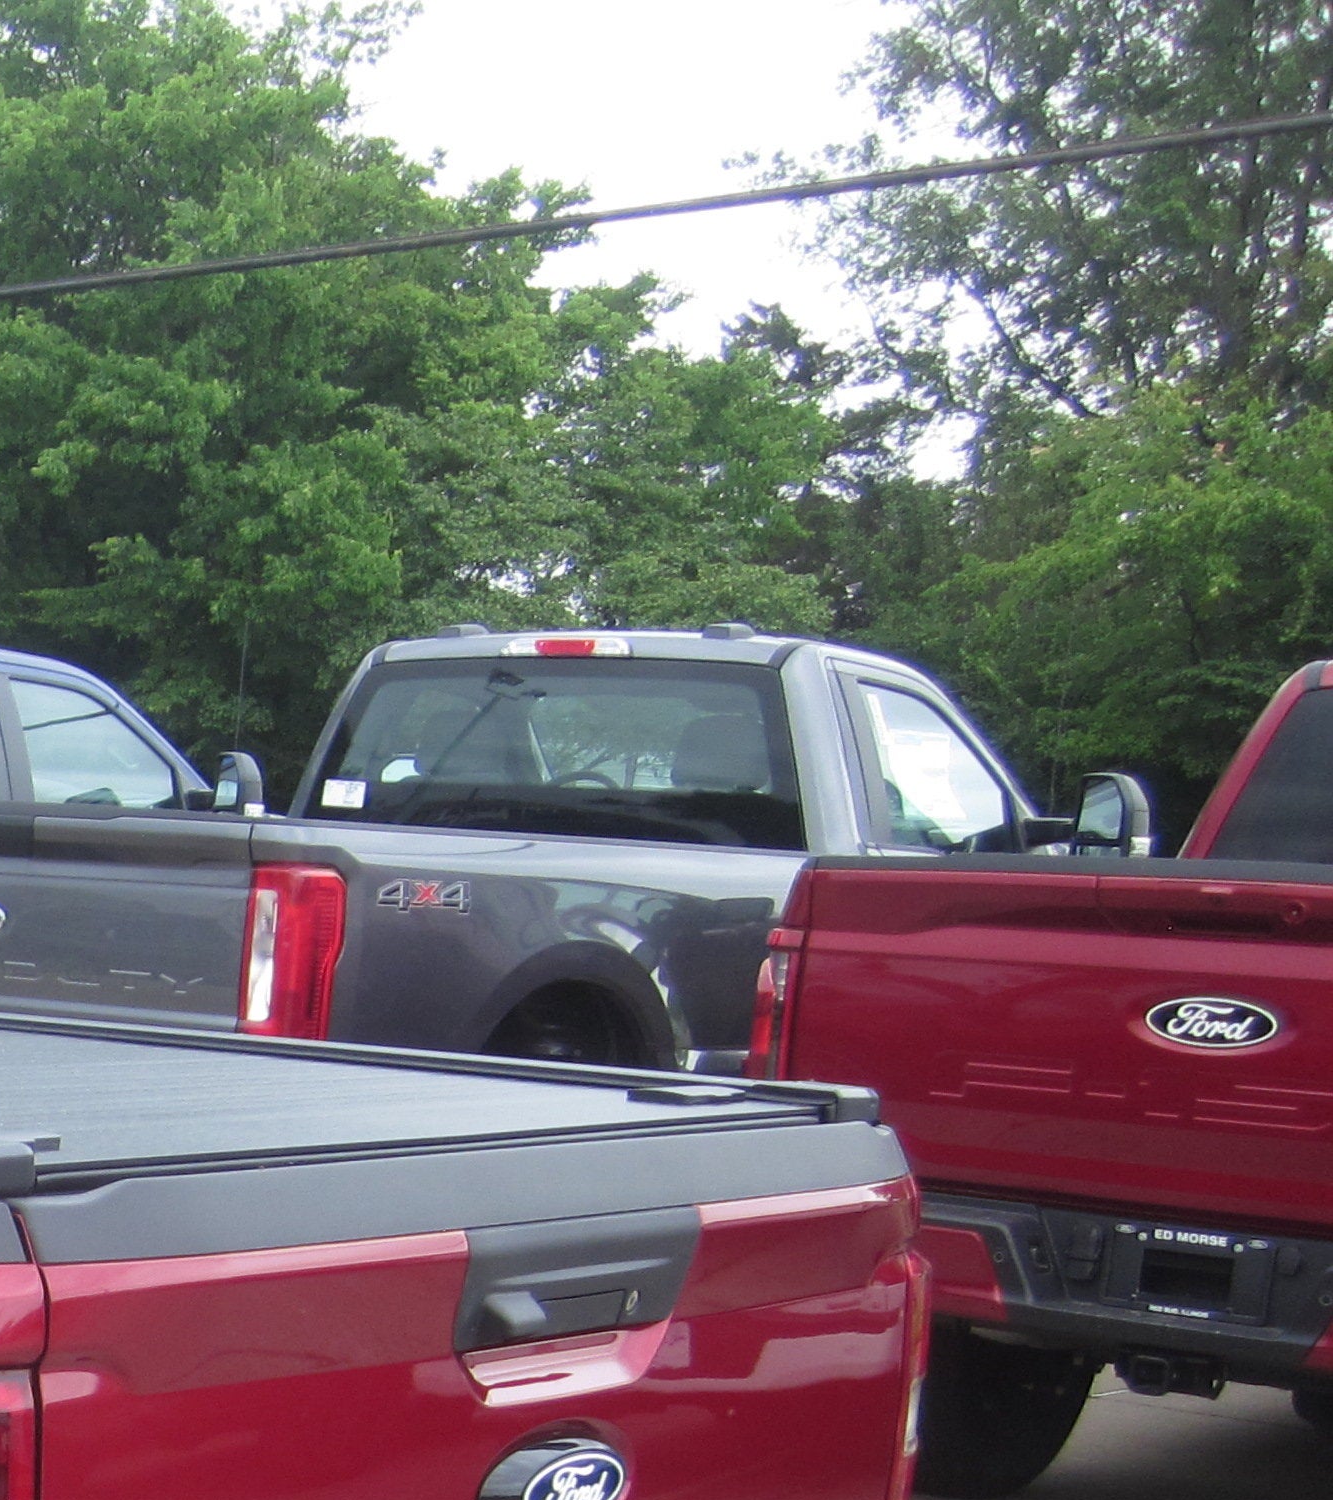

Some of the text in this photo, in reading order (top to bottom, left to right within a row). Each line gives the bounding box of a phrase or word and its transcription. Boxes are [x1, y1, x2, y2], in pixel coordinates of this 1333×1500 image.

[1166, 1003, 1255, 1041] Ford
[1153, 1228, 1174, 1241] ED
[1176, 1231, 1229, 1248] MORSE
